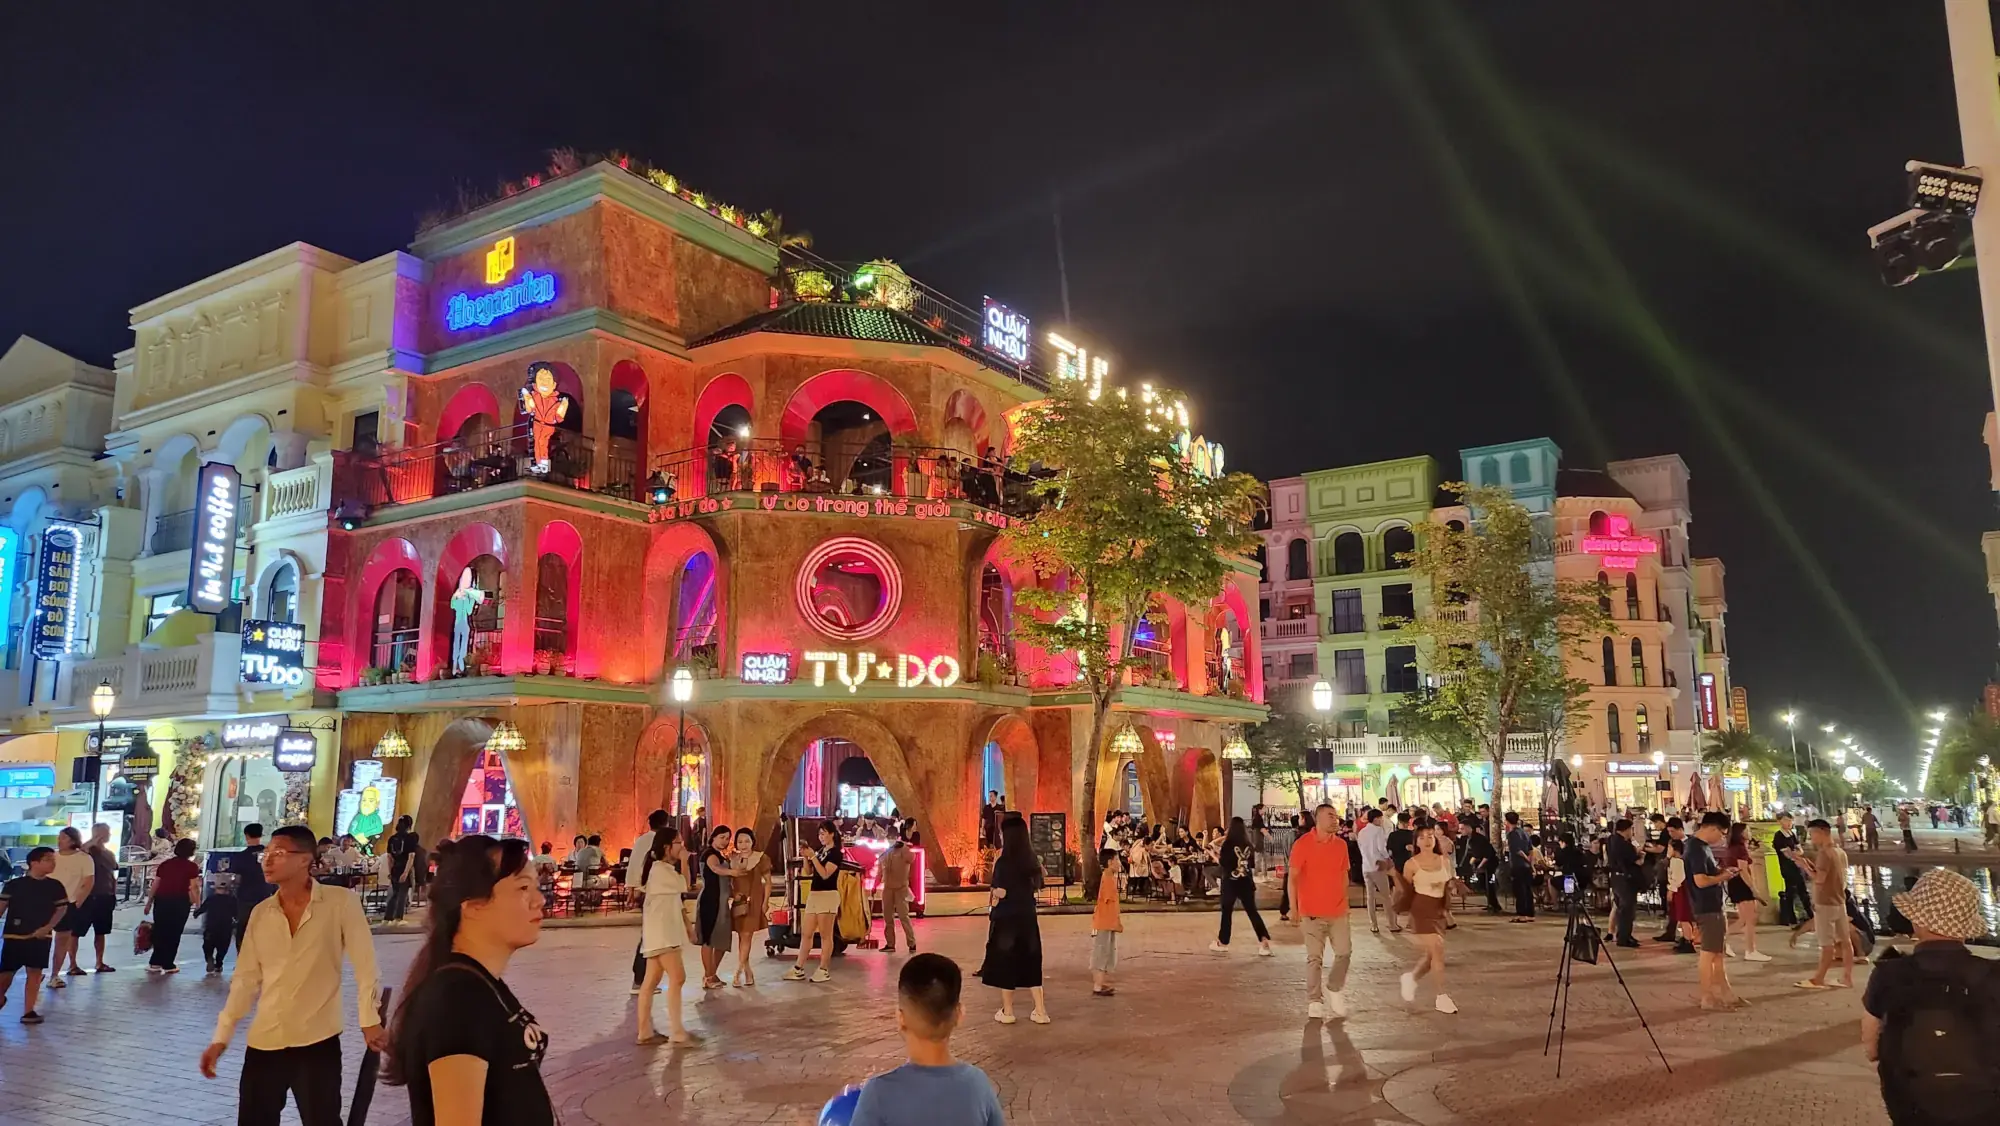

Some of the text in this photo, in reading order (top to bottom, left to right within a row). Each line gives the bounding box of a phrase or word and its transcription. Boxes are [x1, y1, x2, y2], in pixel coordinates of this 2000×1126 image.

[699, 497, 719, 513] do
[784, 495, 810, 511] do
[816, 496, 869, 518] trong
[271, 665, 304, 685] DO
[804, 650, 960, 693] TỰ DO
